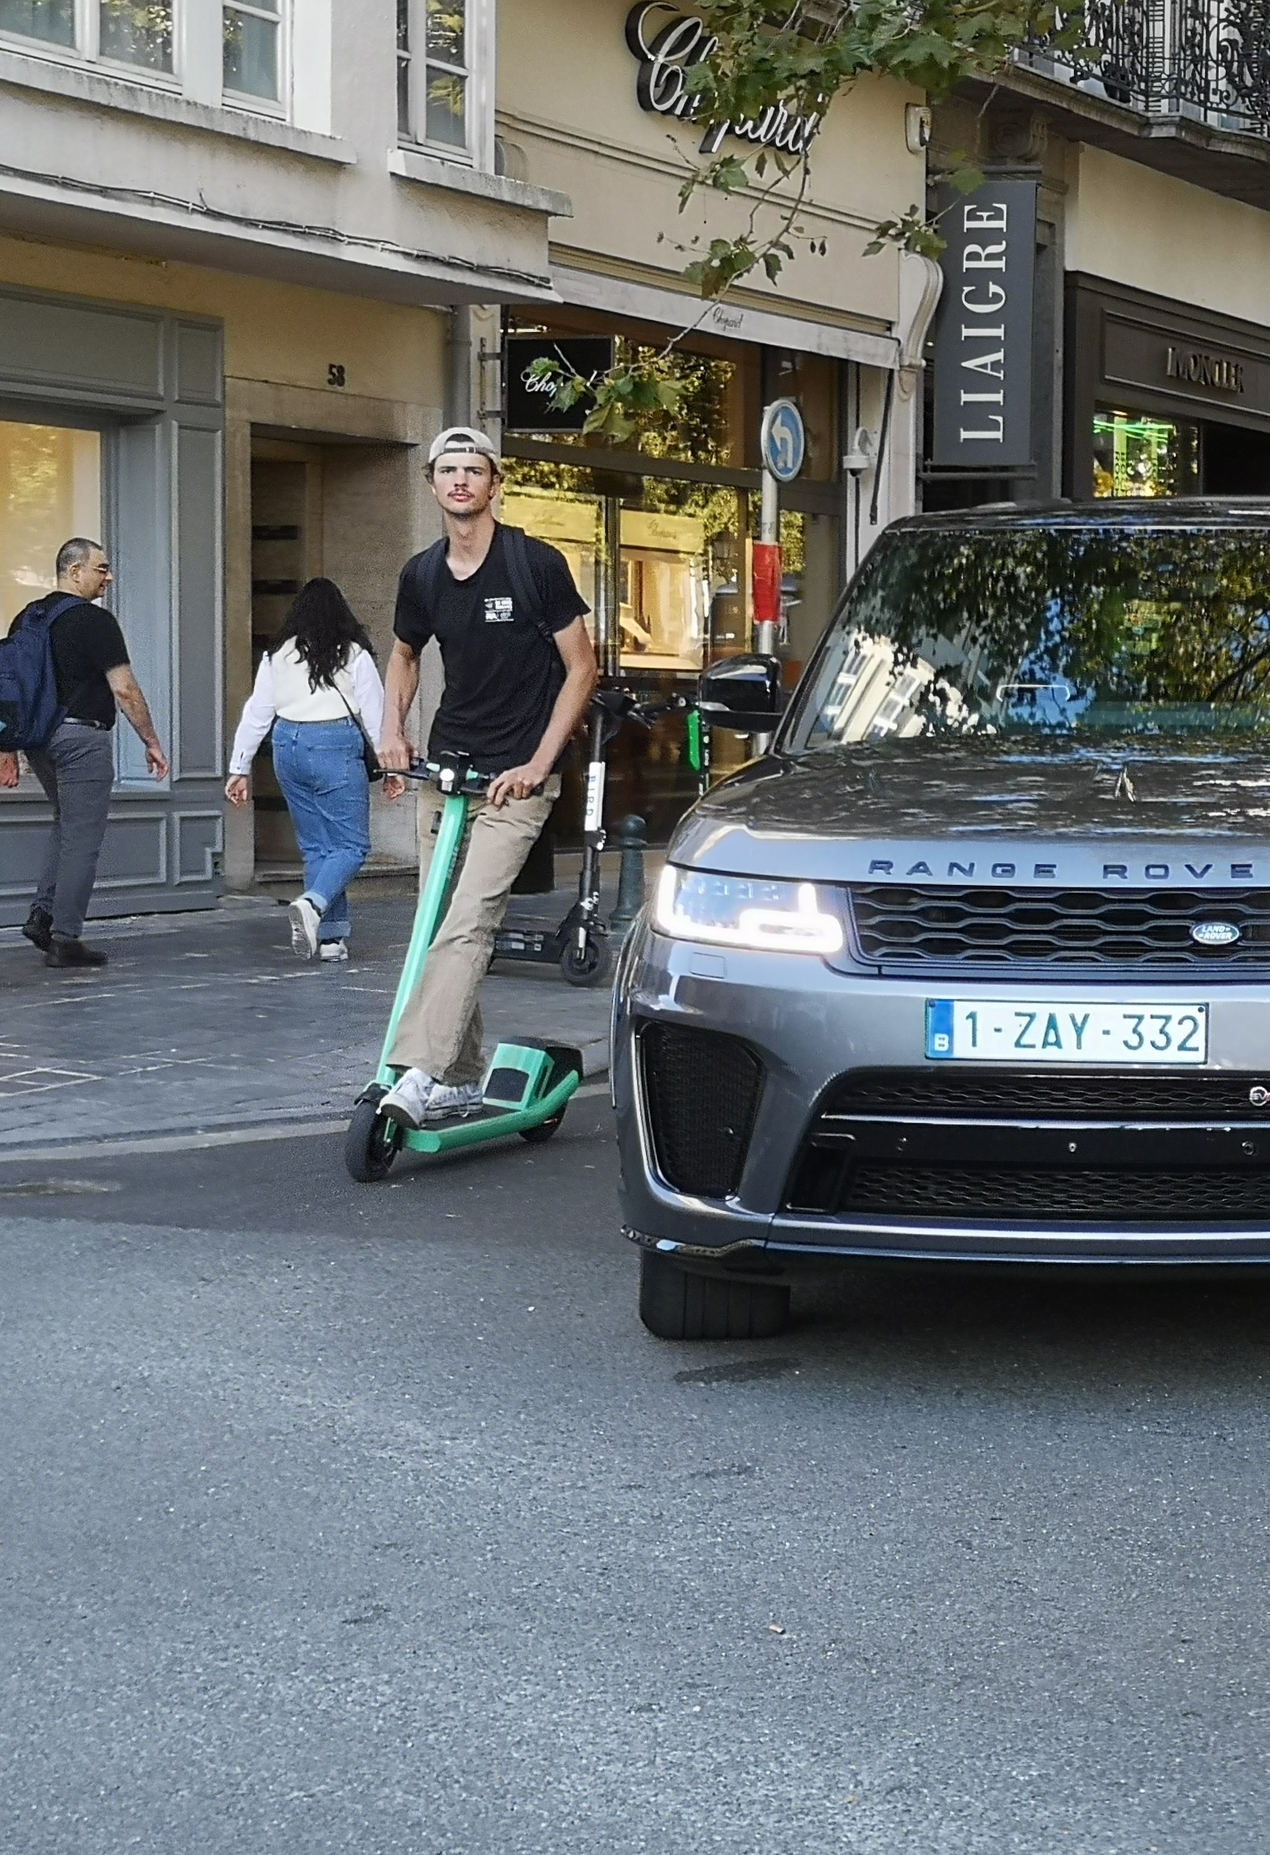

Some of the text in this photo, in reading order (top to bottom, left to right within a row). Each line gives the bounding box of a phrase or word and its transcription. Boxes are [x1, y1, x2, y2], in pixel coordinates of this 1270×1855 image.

[960, 203, 1007, 443] LIAIGRE
[868, 859, 1057, 879] RANGE
[934, 1033, 949, 1051] B
[965, 1010, 1201, 1052] 1-ZAY-332
